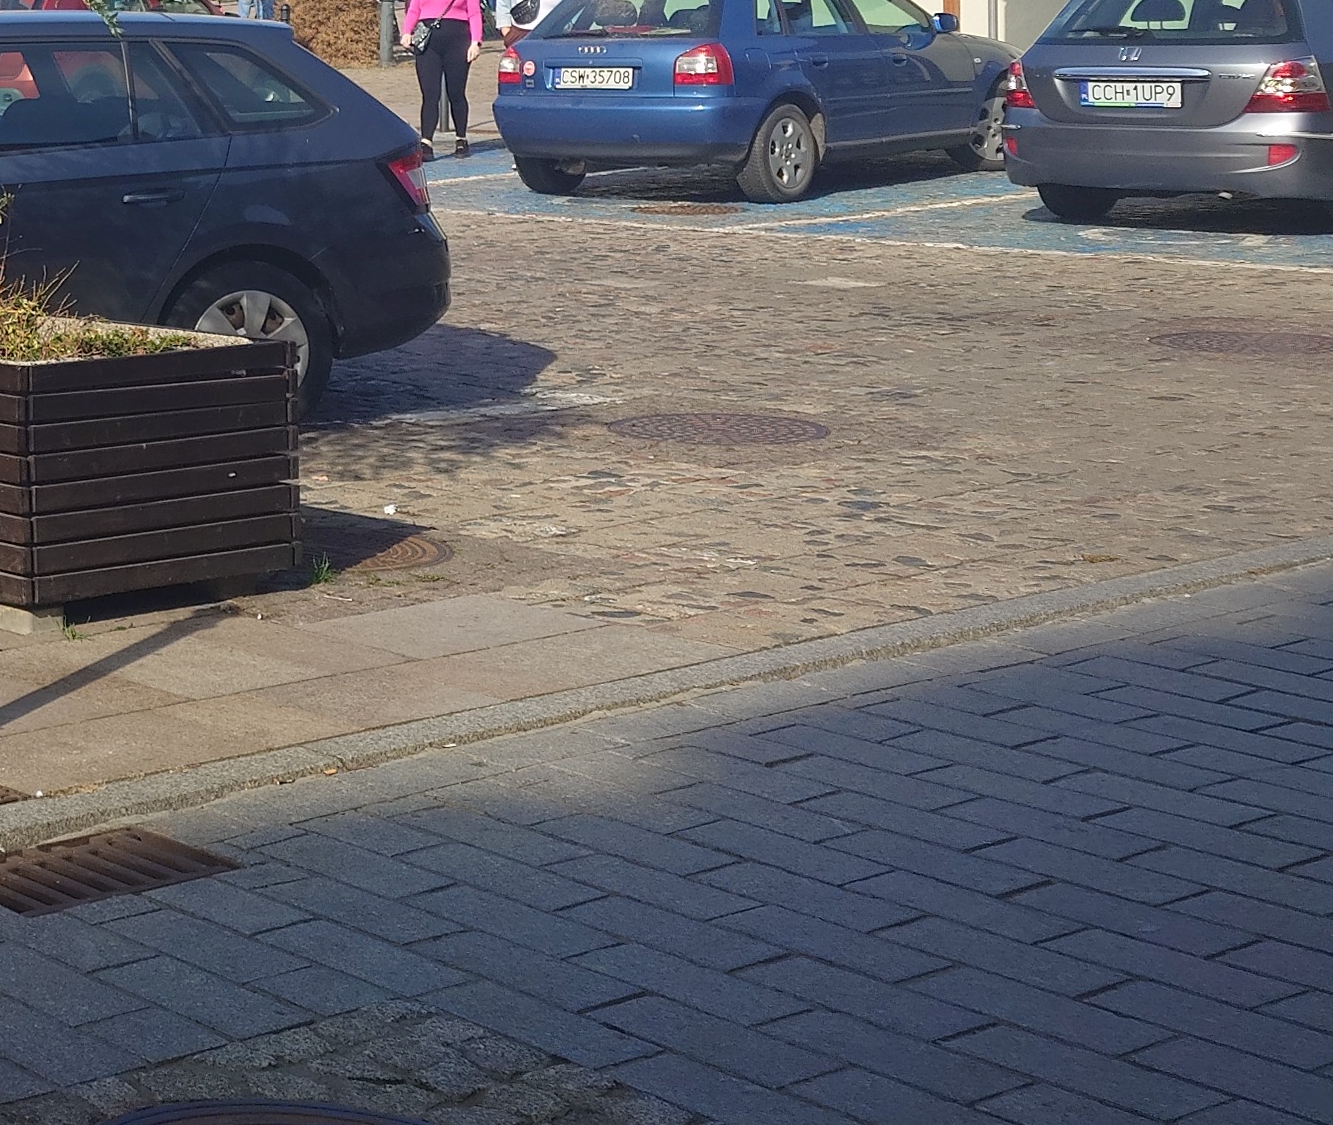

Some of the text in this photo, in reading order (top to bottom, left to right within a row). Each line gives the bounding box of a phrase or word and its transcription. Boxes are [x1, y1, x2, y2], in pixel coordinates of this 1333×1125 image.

[590, 70, 630, 84] 35708
[1092, 85, 1124, 101] CCH
[1133, 85, 1176, 101] 1UP9
